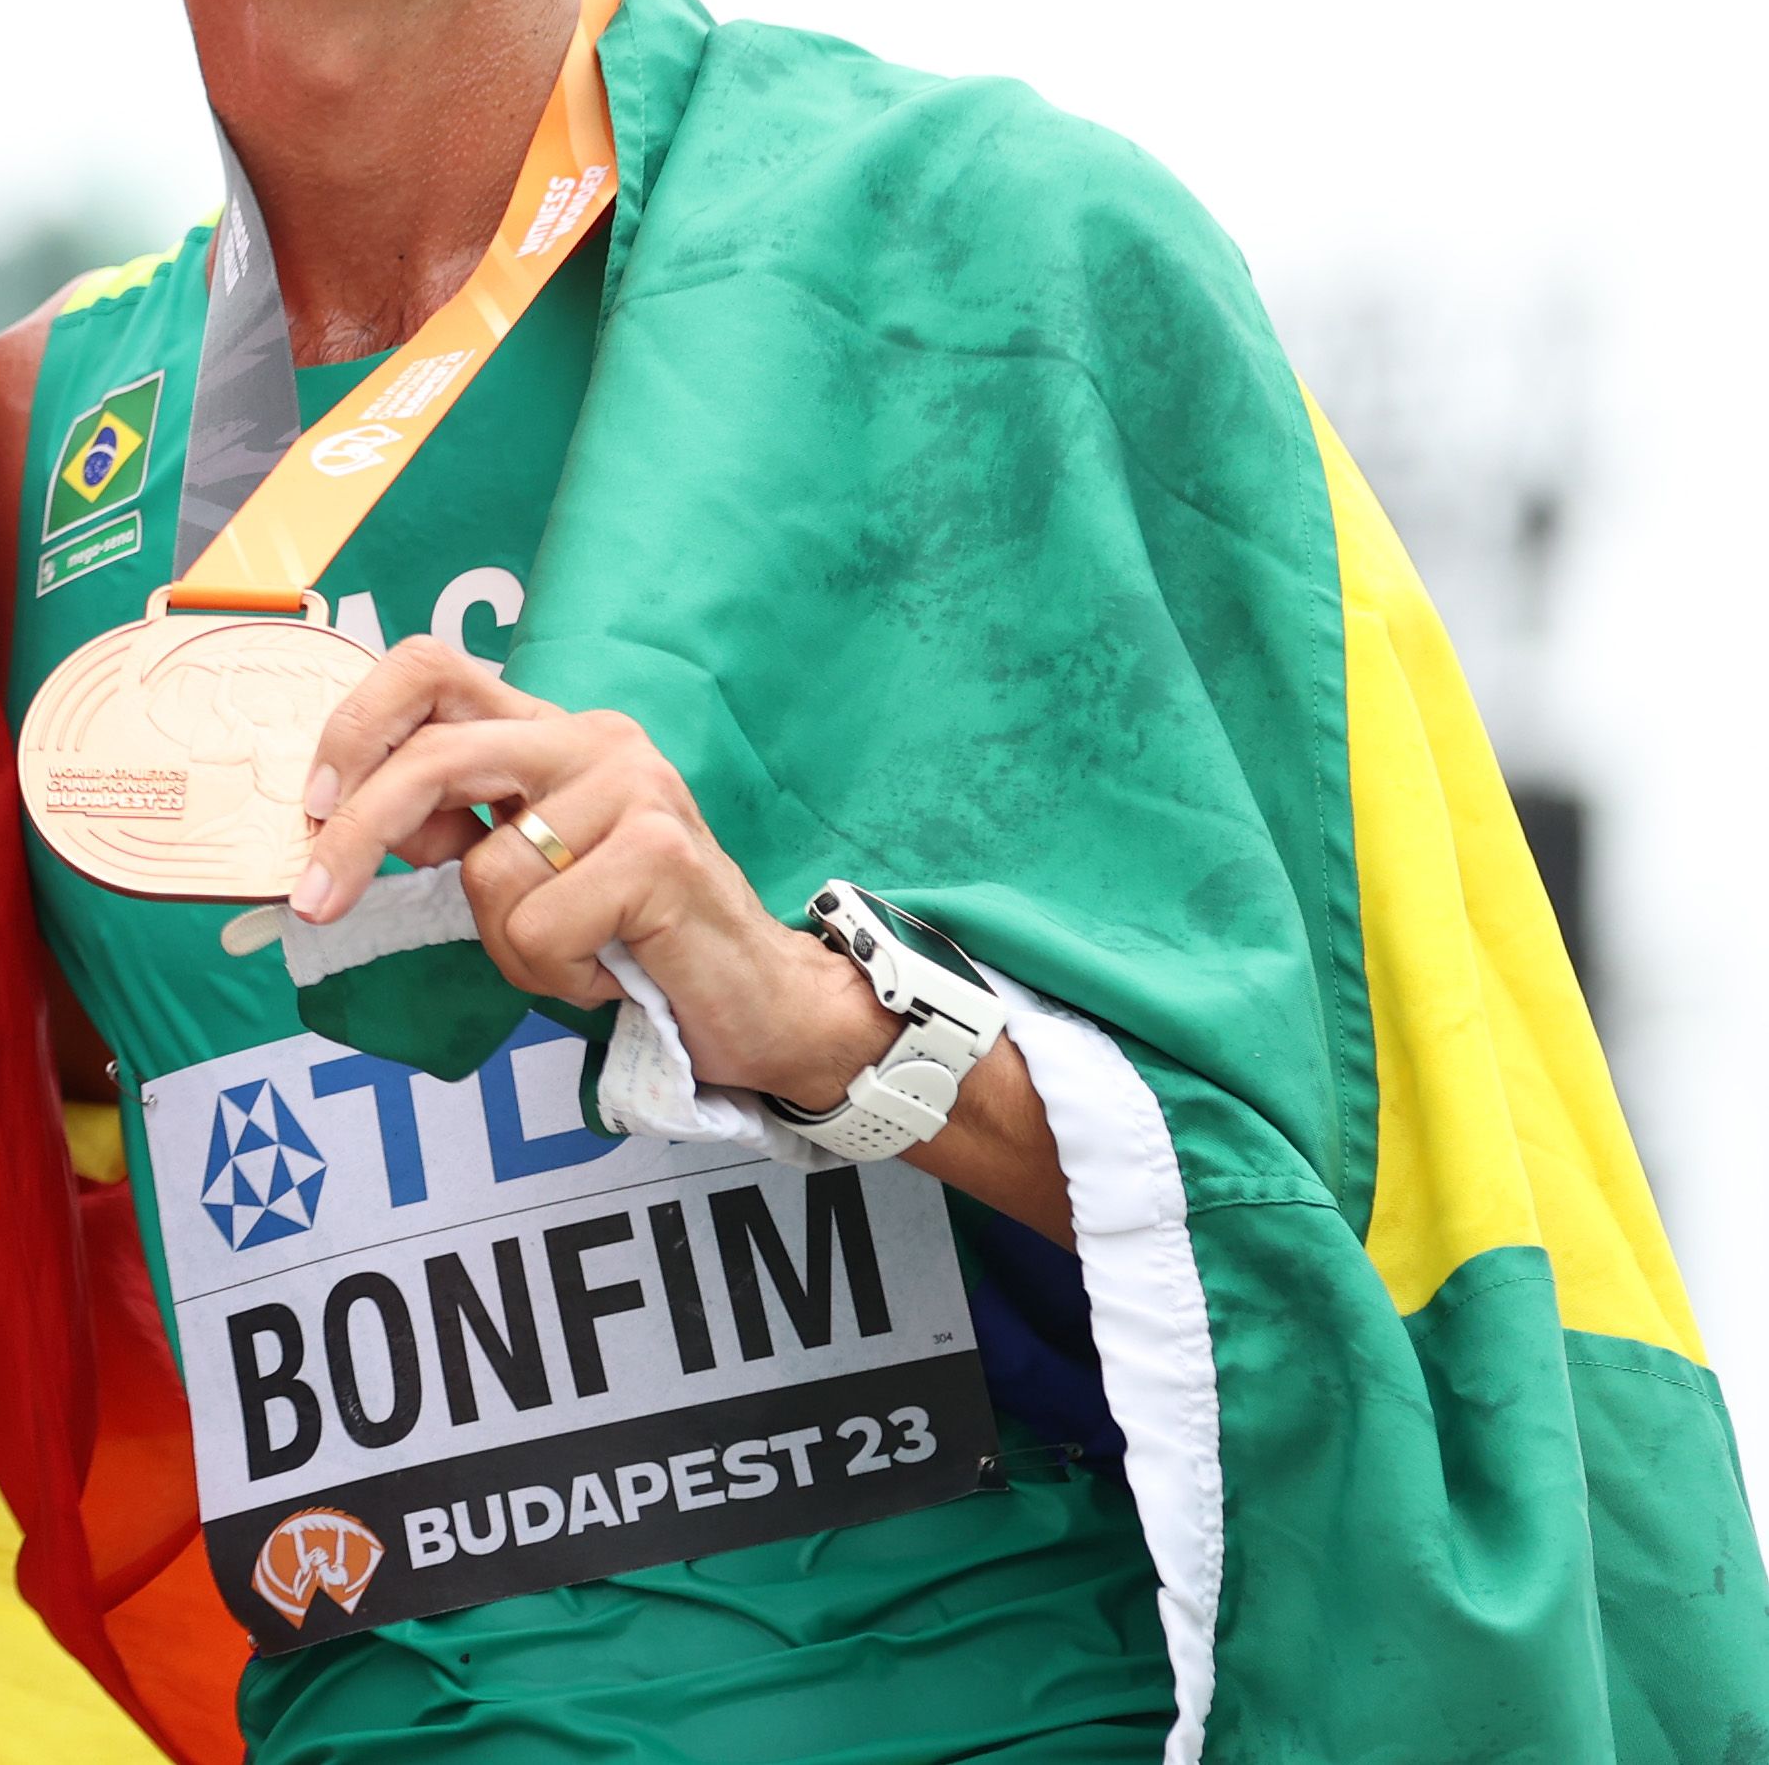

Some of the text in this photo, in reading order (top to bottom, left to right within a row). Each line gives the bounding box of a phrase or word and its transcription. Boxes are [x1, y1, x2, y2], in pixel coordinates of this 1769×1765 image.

[515, 175, 576, 259] WITNESS
[47, 780, 187, 795] CHAMPIONSHIPS
[47, 791, 184, 810] BUDAPEST 23
[48, 766, 188, 781] WORLD ATHLETICS
[309, 1009, 685, 1209] TD
[226, 1164, 893, 1481] BONFIM
[403, 1404, 939, 1571] BUDAPEST 23
